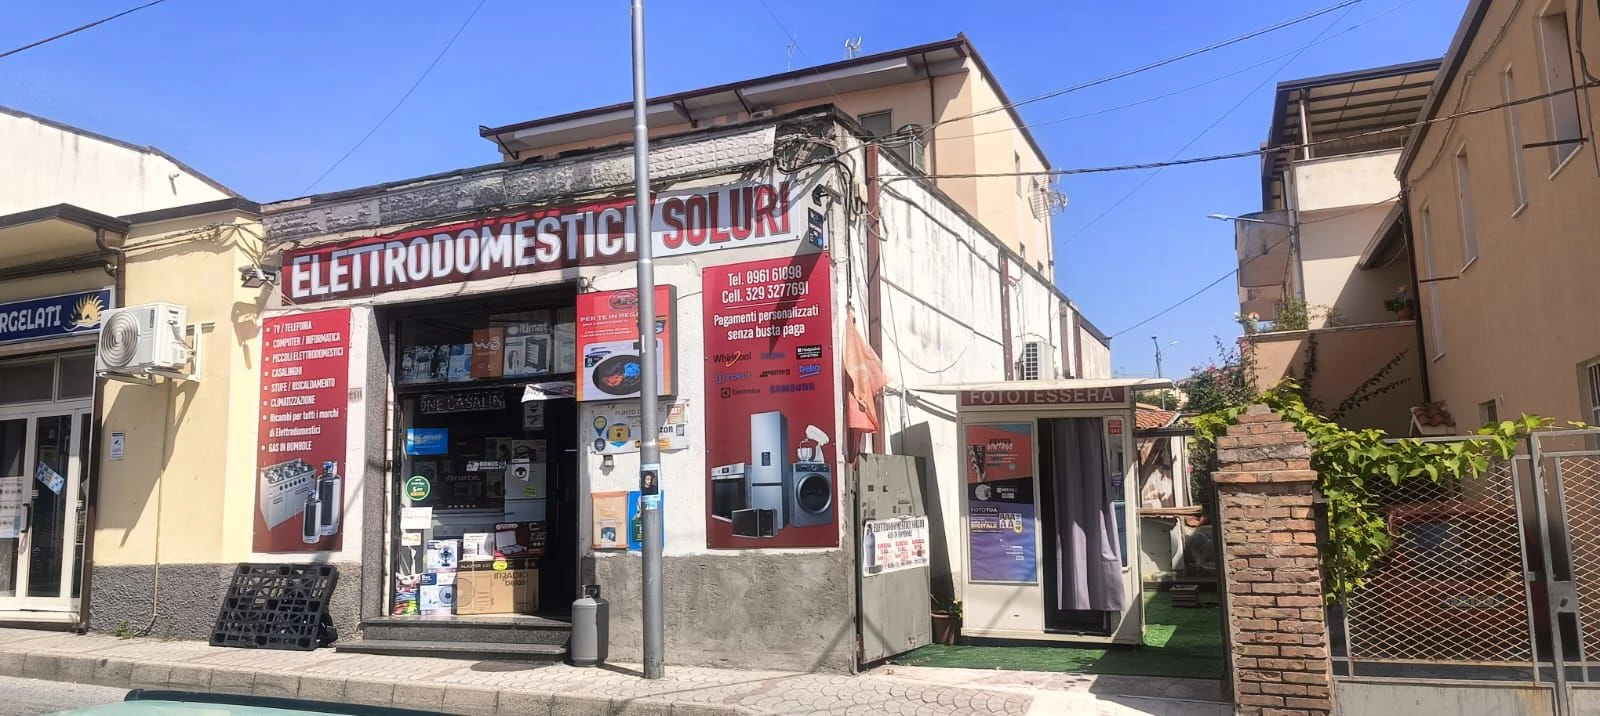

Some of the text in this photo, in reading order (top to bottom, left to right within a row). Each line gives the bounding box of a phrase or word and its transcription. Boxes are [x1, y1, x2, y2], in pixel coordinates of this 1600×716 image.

[291, 205, 637, 298] ELETTRODOMESTICI
[662, 180, 792, 249] SOLURI
[728, 265, 802, 287] Tel. 0961 61098
[722, 281, 809, 303] Cell. 329 3277691
[714, 304, 819, 327] Pagamenti personalizzati
[285, 320, 312, 333] TELEFONIA
[727, 323, 805, 341] senza busta paga
[273, 337, 301, 348] COMPUTER
[305, 332, 341, 345] INFORMATICA
[272, 347, 344, 363] PICCOLI ELETTRODOMESTICI
[271, 366, 303, 378] CASALINGHI
[799, 363, 820, 373] beko
[271, 382, 288, 393] STUFE
[292, 377, 336, 391] RISCALDAMENTO
[270, 395, 316, 407] CLIMATIZZAZIONE
[270, 412, 292, 422] Ricambi
[292, 413, 302, 422] per
[303, 410, 315, 420] tutti
[319, 407, 339, 418] marchi
[275, 425, 321, 437] Elettrodomestici
[268, 440, 312, 453] GAS IN BOMBOLE
